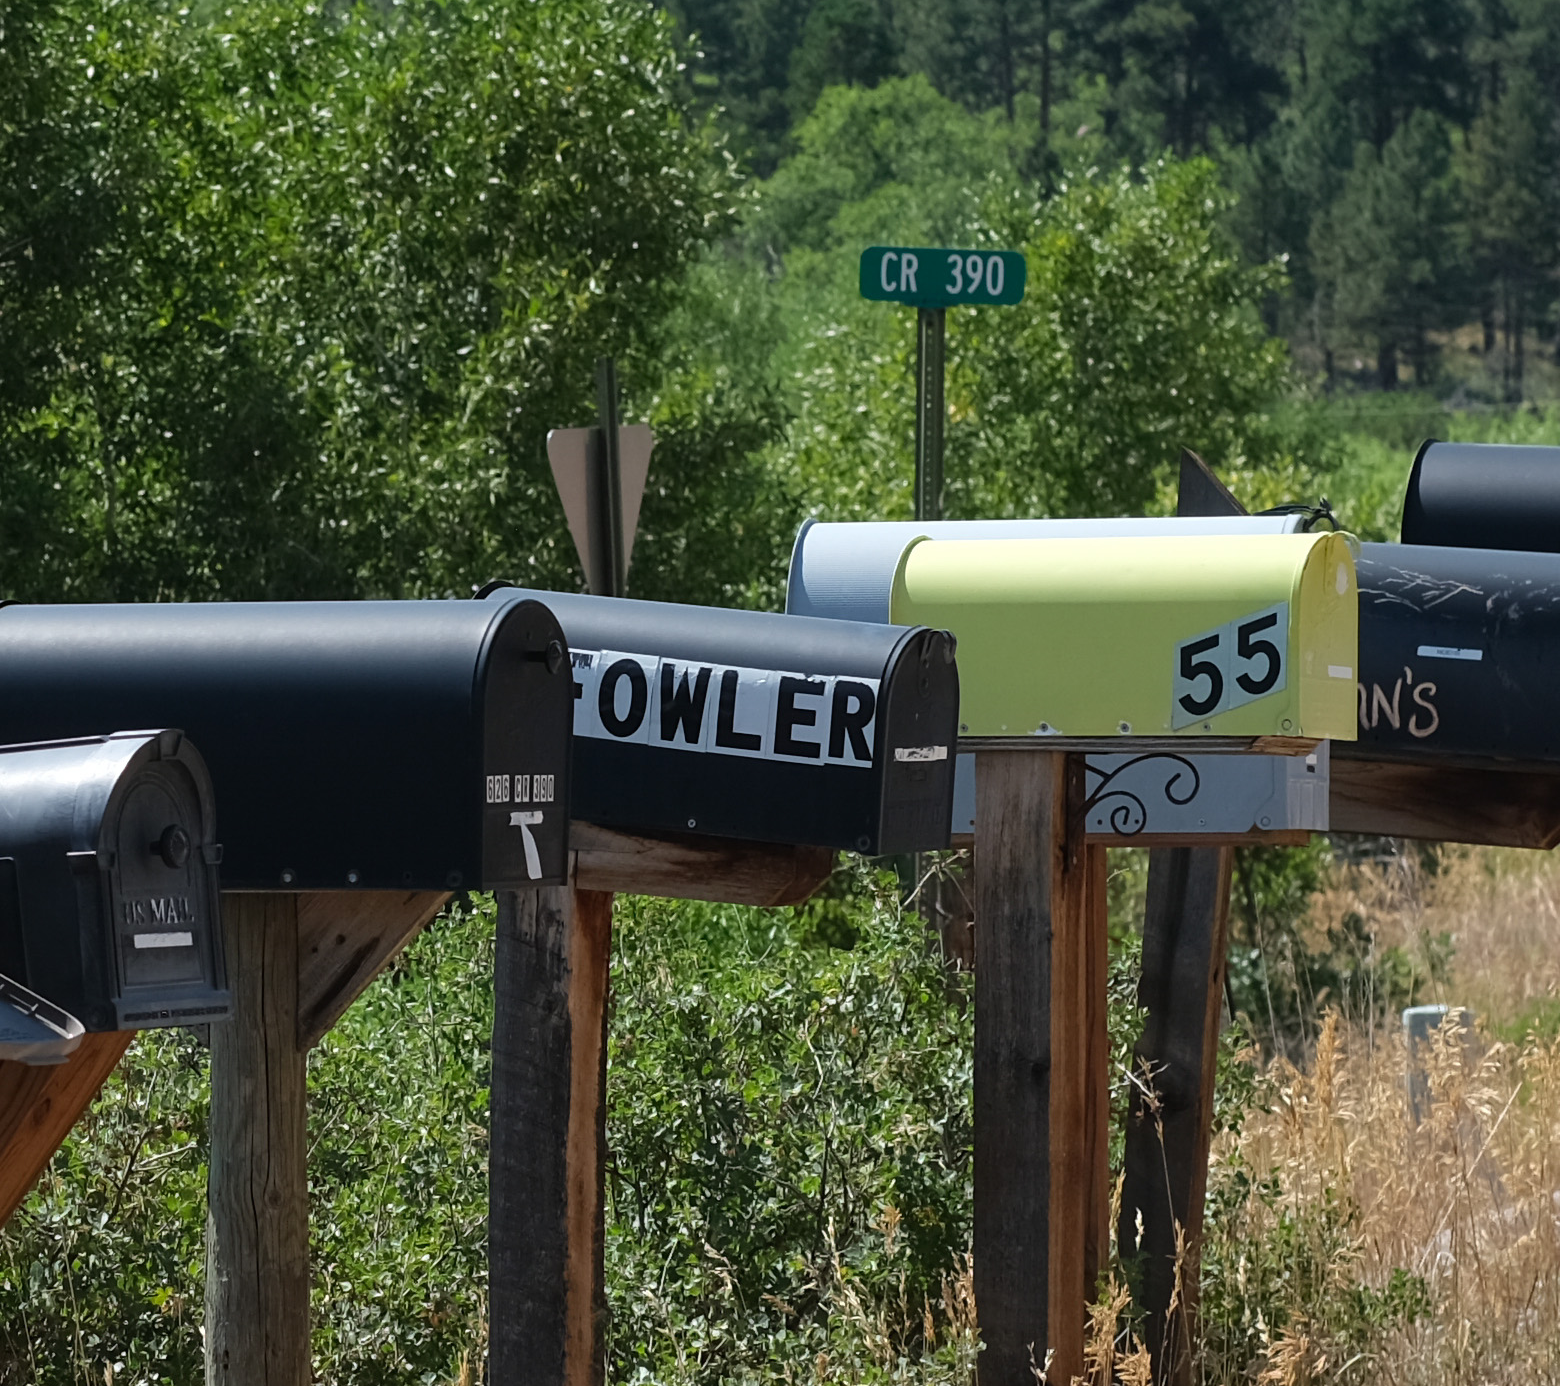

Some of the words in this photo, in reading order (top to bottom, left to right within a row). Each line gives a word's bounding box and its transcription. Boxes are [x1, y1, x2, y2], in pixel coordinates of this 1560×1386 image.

[880, 252, 919, 293] CR
[945, 254, 1005, 296] 390
[1178, 612, 1282, 716] 55
[487, 777, 509, 801] 626
[533, 776, 554, 800] 390
